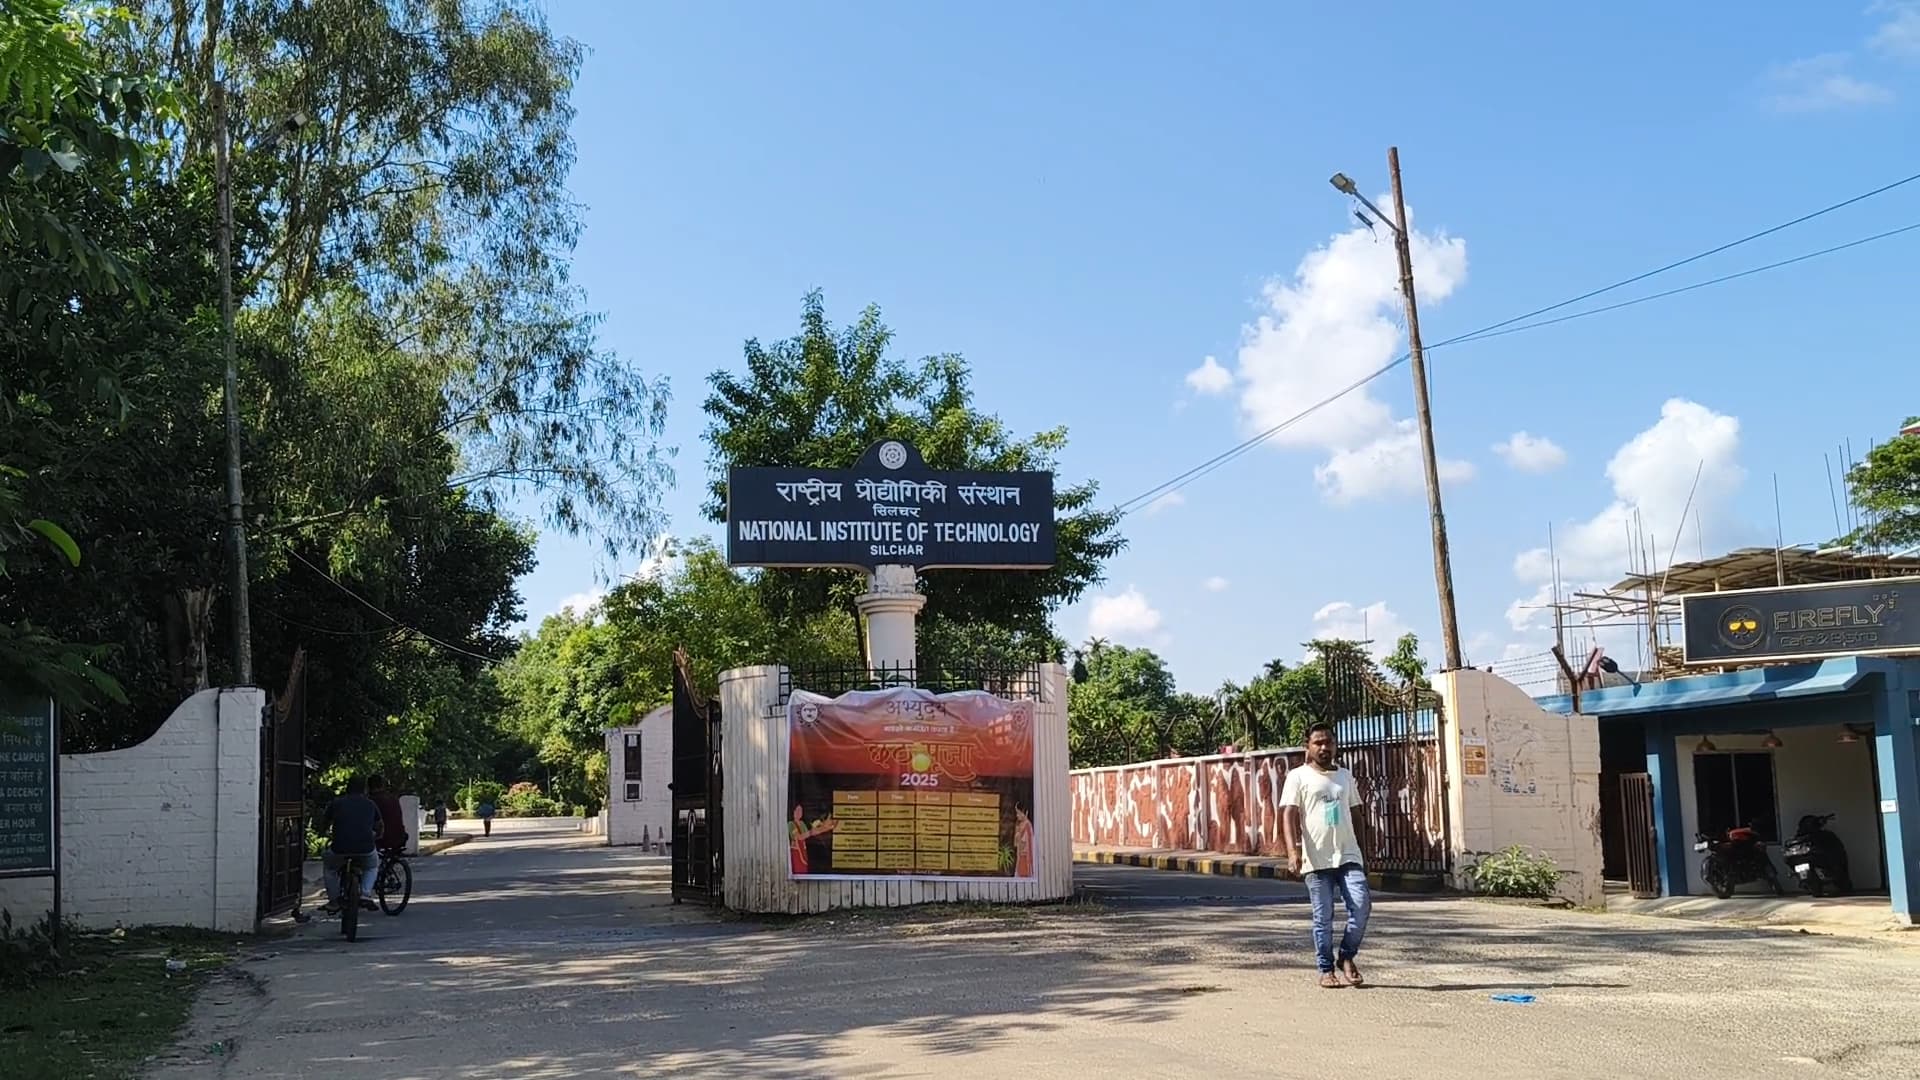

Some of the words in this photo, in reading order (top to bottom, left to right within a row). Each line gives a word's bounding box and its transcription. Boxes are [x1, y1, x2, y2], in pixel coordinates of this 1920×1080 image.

[776, 478, 842, 506] राष्ट्रीय
[855, 478, 947, 504] प्रौद्योगिकी
[958, 482, 1020, 506] संस्थान
[872, 503, 921, 518] सिलचर
[739, 520, 818, 541] NATIONAL
[821, 521, 903, 541] INSTITUTE
[907, 522, 928, 542] OF
[934, 523, 1040, 543] TECHNOLOGY
[870, 544, 924, 556] SILCHAR
[1773, 603, 1885, 631] FIREFLY
[12, 752, 45, 763] CAMPUS
[901, 773, 938, 786] 2025
[7, 786, 44, 797] DECENCY
[12, 818, 35, 829] HOUR
